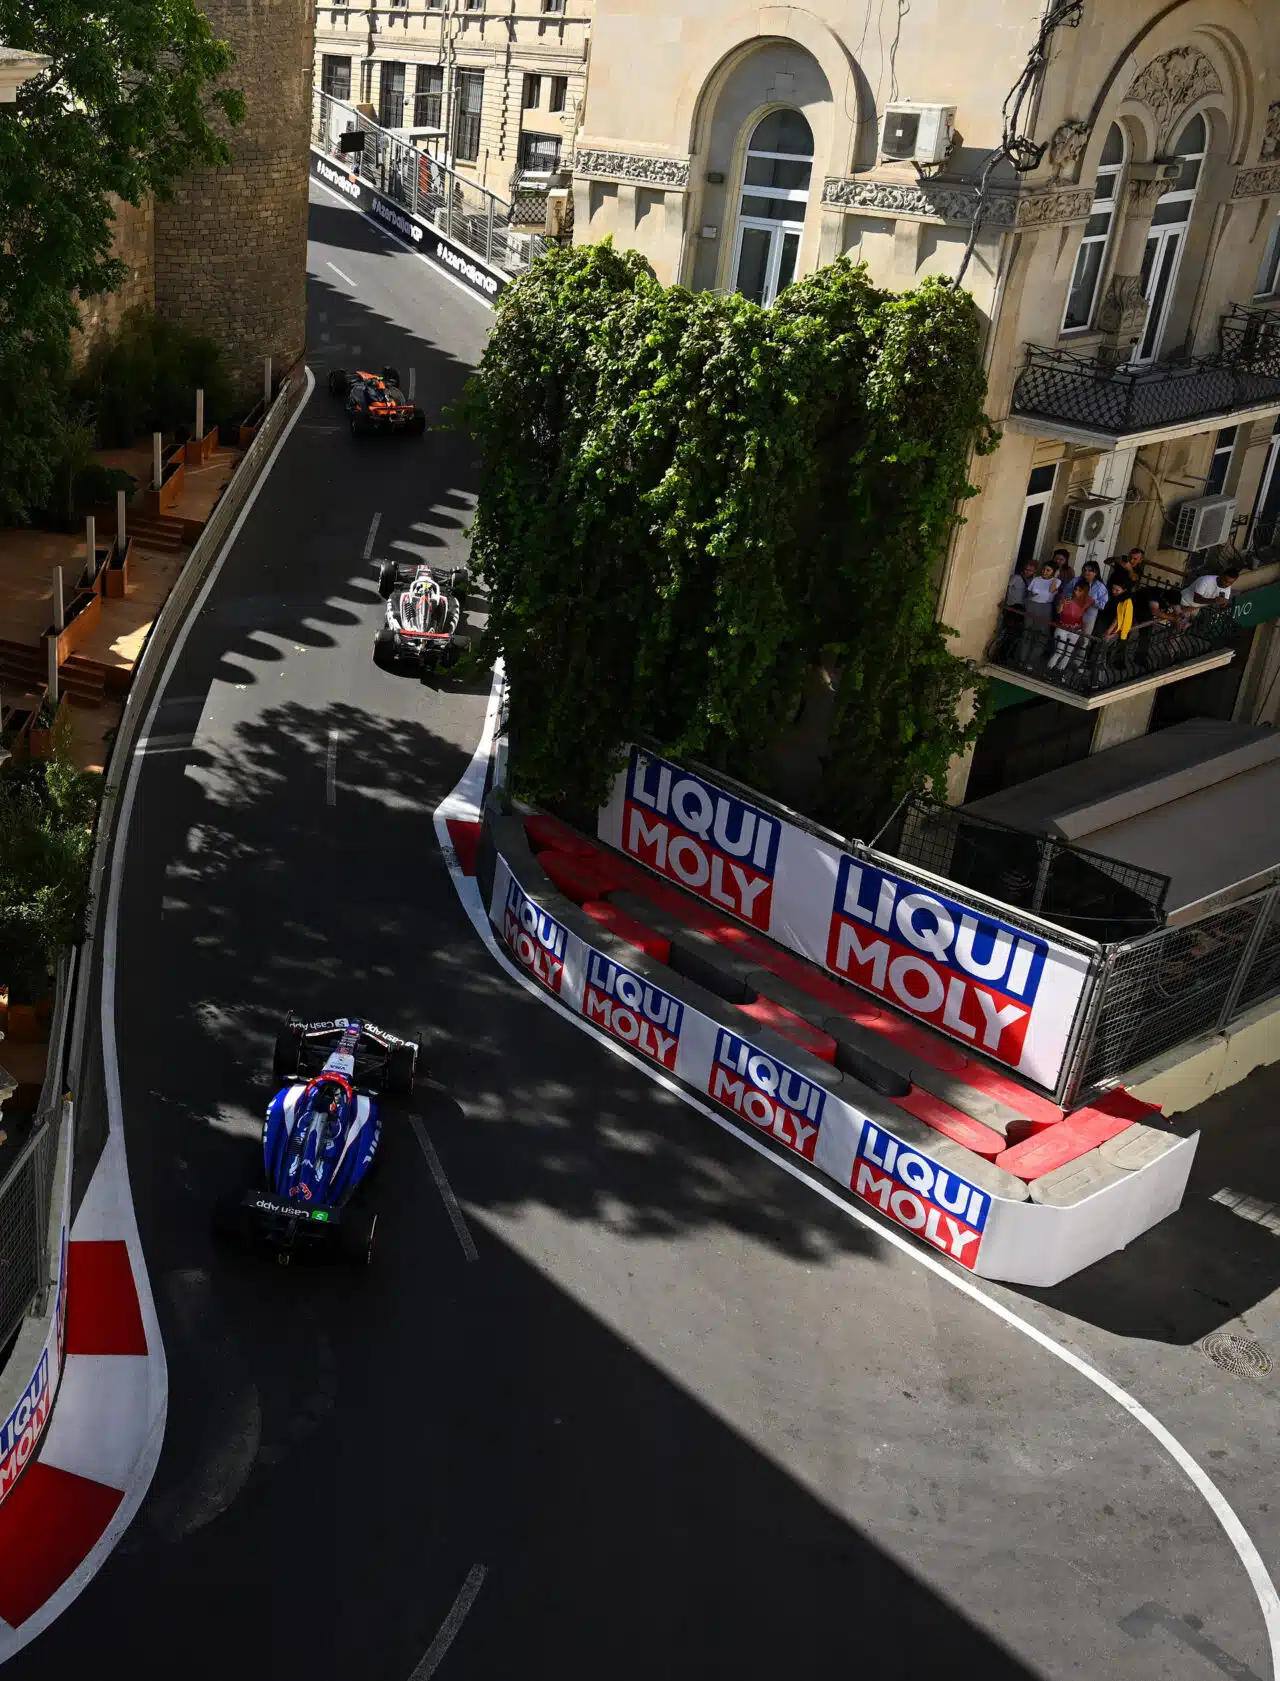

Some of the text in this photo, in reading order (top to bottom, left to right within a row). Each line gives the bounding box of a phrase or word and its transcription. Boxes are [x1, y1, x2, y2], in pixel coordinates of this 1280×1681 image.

[436, 242, 498, 295] #AzerbaijanGP
[633, 753, 772, 869] LIQUI
[631, 808, 770, 919] MOLY
[507, 917, 563, 986] MOLY
[509, 882, 564, 958] LIQUI
[843, 863, 1036, 996] LIQUI
[310, 1020, 335, 1030] Cash
[587, 989, 677, 1062] MOLY
[591, 954, 678, 1032] LIQUI
[838, 923, 1028, 1052] MOLY
[364, 1022, 405, 1046] Cash App
[714, 1068, 816, 1151] MOLY
[720, 1034, 822, 1120] LIQUI
[255, 1199, 280, 1212] App
[861, 1163, 979, 1258] MOLY
[863, 1126, 984, 1226] LIQUI
